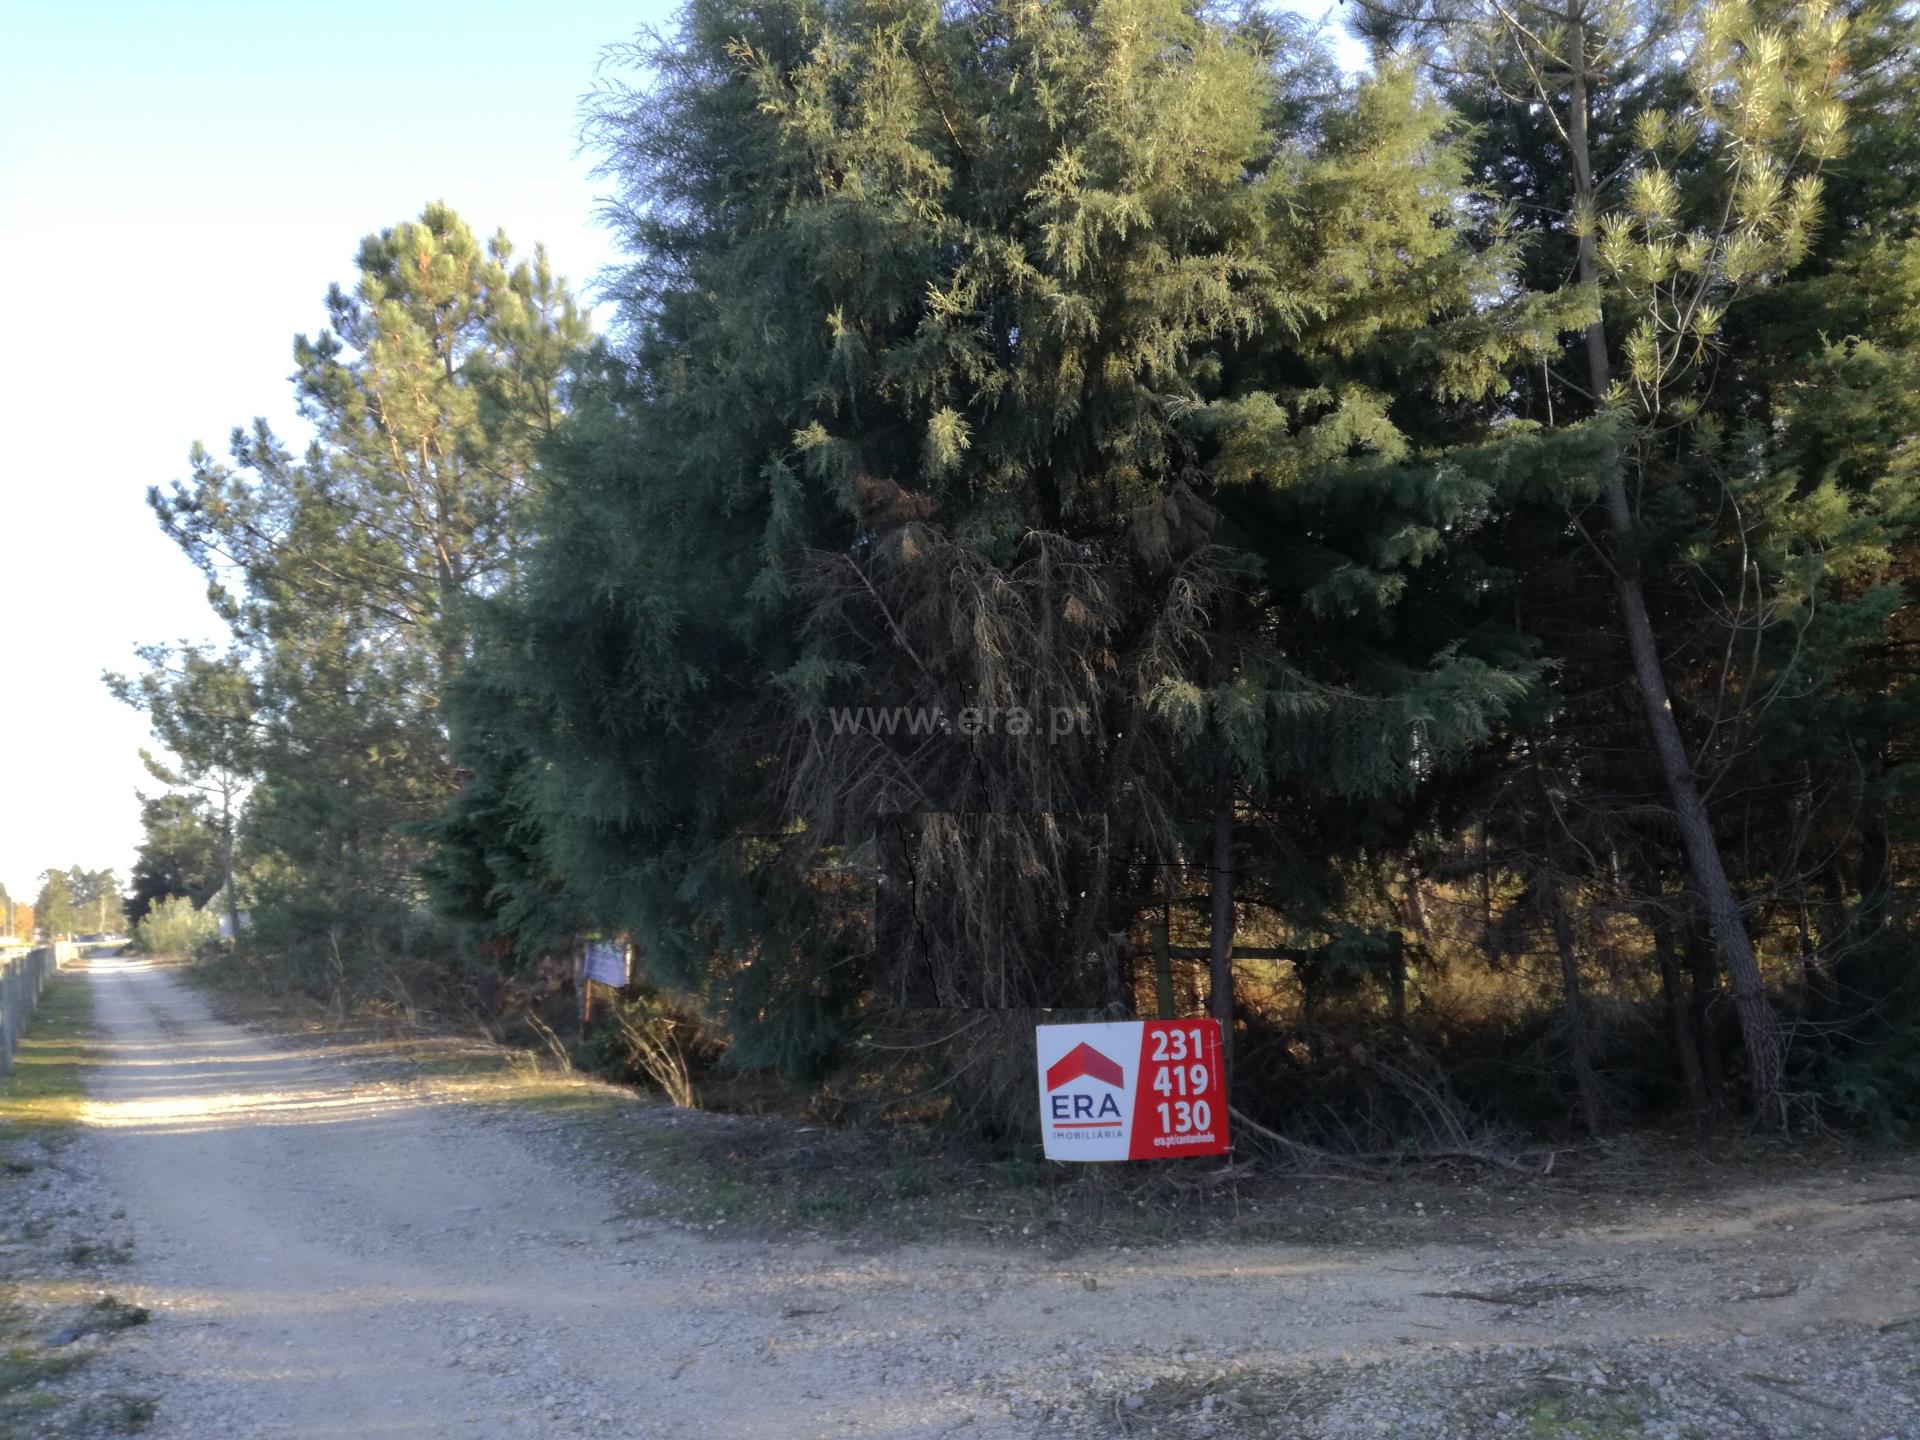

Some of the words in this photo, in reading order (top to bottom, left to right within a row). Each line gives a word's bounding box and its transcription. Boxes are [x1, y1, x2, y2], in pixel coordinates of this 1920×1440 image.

[1151, 1029, 1203, 1061] 231
[1153, 1064, 1208, 1097] 419
[1051, 1093, 1122, 1119] ERA
[1157, 1100, 1211, 1133] 130
[1053, 1129, 1124, 1140] IMOBILIÁRIA
